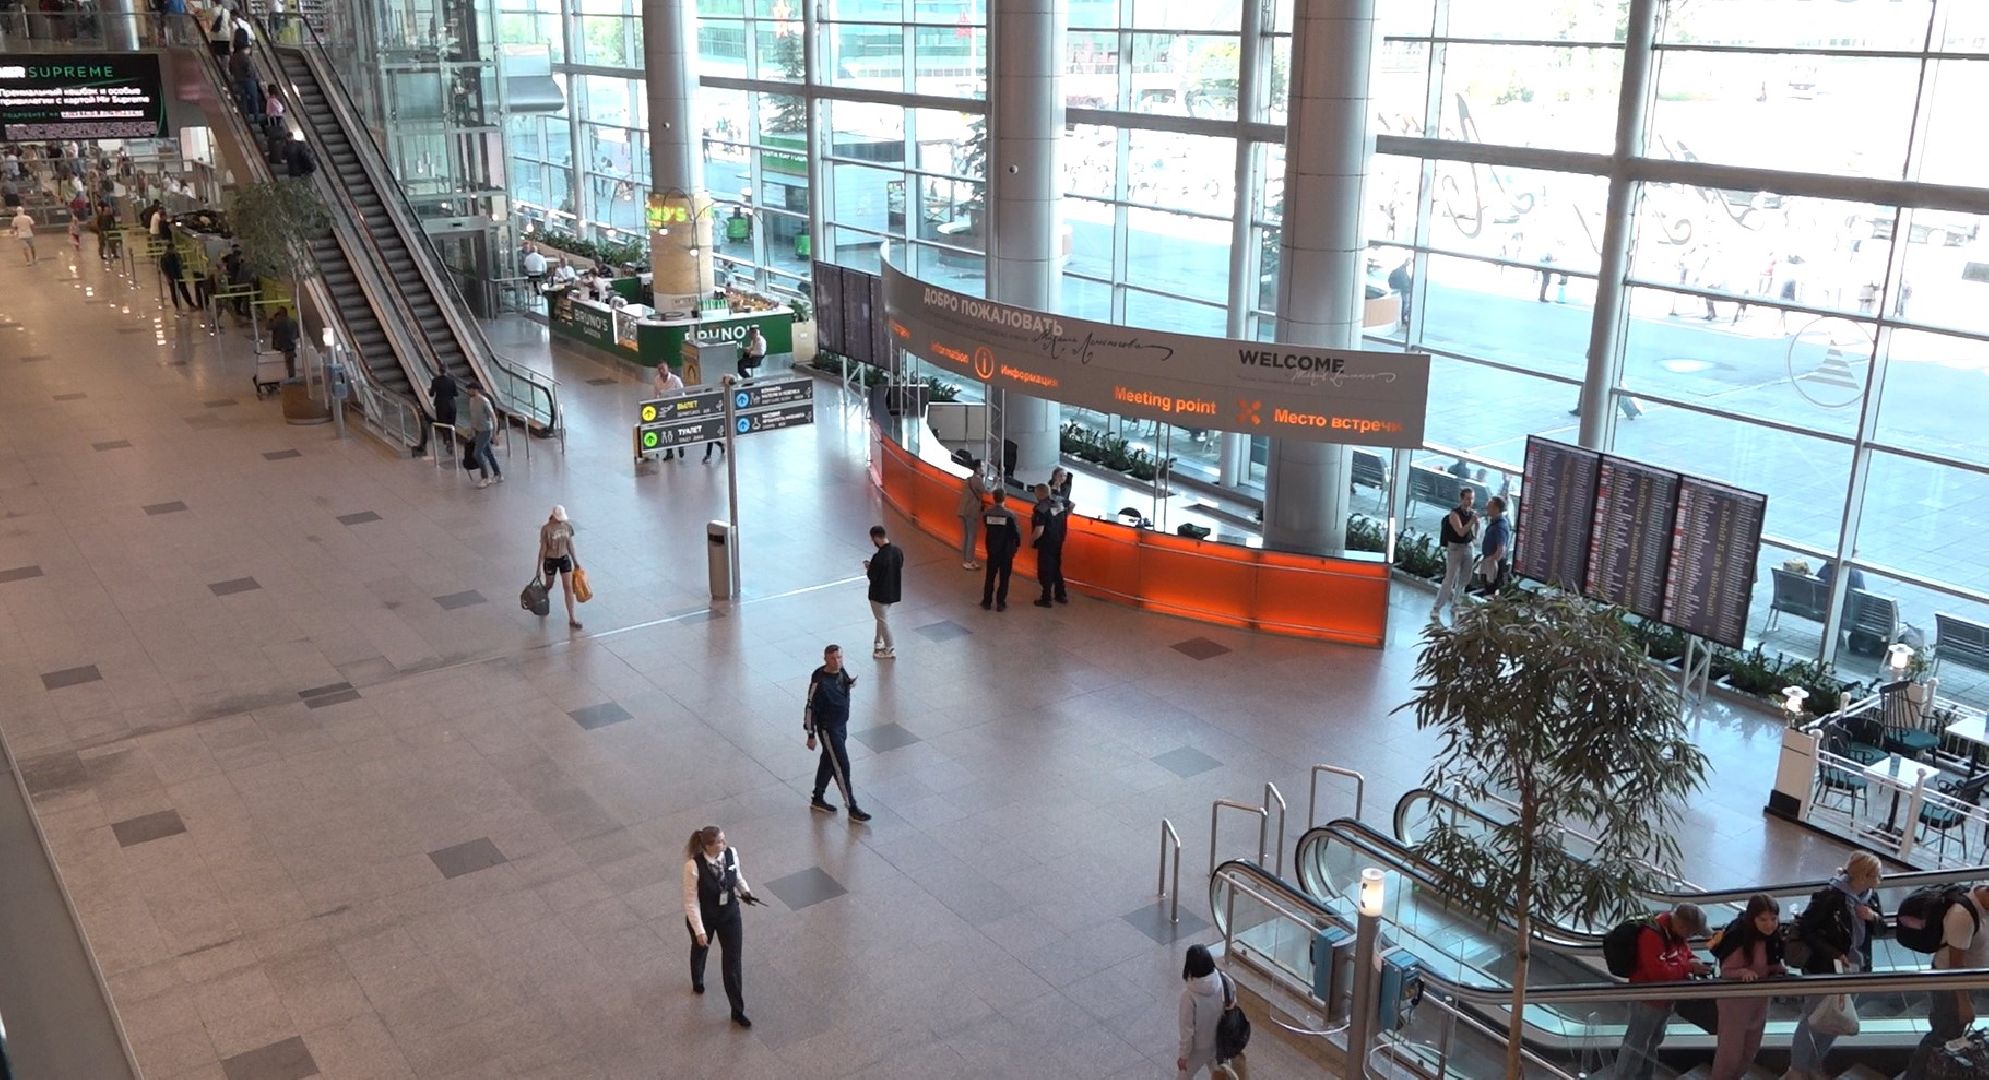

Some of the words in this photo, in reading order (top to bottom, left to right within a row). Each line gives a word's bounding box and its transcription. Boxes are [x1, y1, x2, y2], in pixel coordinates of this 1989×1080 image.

[28, 66, 114, 78] SUPREME
[574, 308, 608, 331] BRUNO'S
[924, 287, 958, 312] ДОБРО
[961, 299, 1064, 336] ПОЖАЛОВАТЬ
[1239, 350, 1345, 373] WELCOME
[1114, 384, 1171, 411] Meeting
[1175, 397, 1216, 415] point
[1274, 409, 1327, 427] Место
[1331, 417, 1404, 433] встречи
